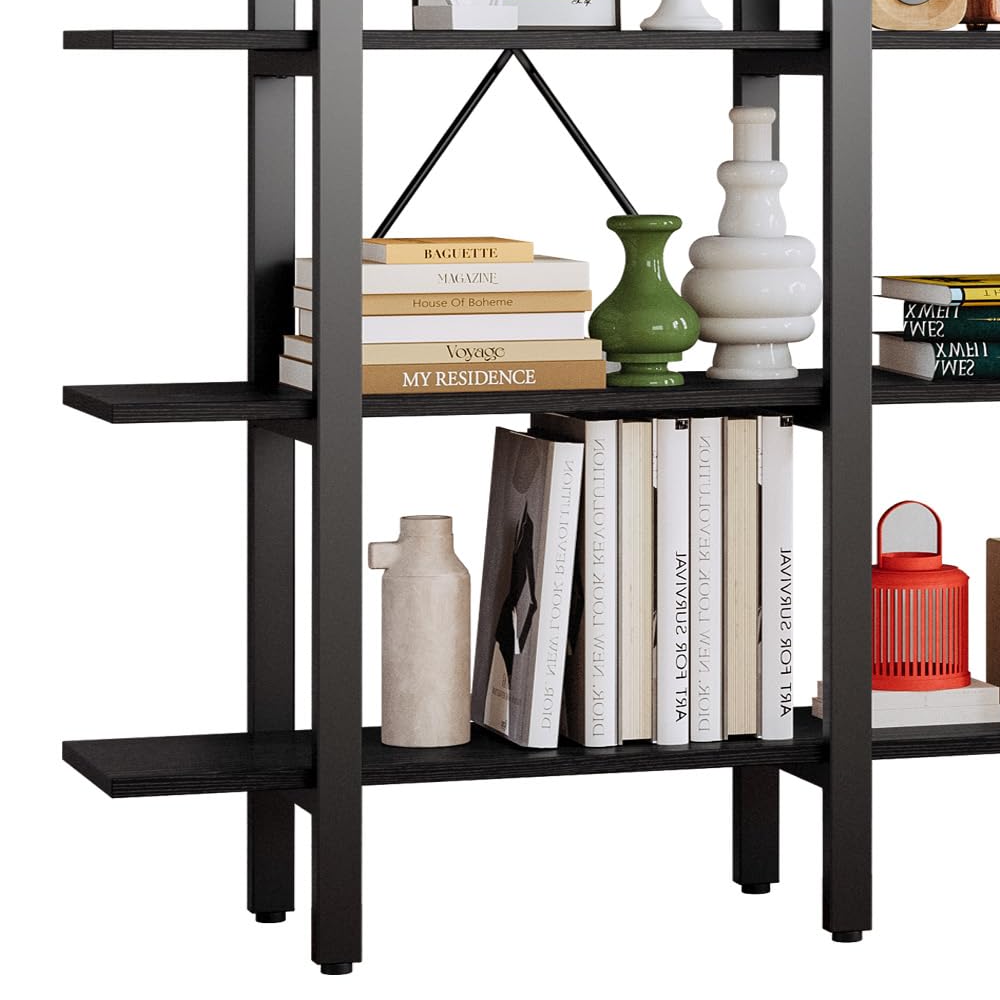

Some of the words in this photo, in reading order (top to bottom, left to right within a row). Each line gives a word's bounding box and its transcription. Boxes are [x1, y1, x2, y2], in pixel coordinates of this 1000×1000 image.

[424, 247, 498, 260] BAGUETTE
[437, 272, 499, 285] MAGAZINE
[412, 298, 448, 309] House
[450, 297, 466, 308] Of
[468, 296, 513, 308] Boheme
[446, 344, 505, 362] Voyage
[402, 372, 434, 388] MY
[434, 369, 537, 387] RESIDENCE
